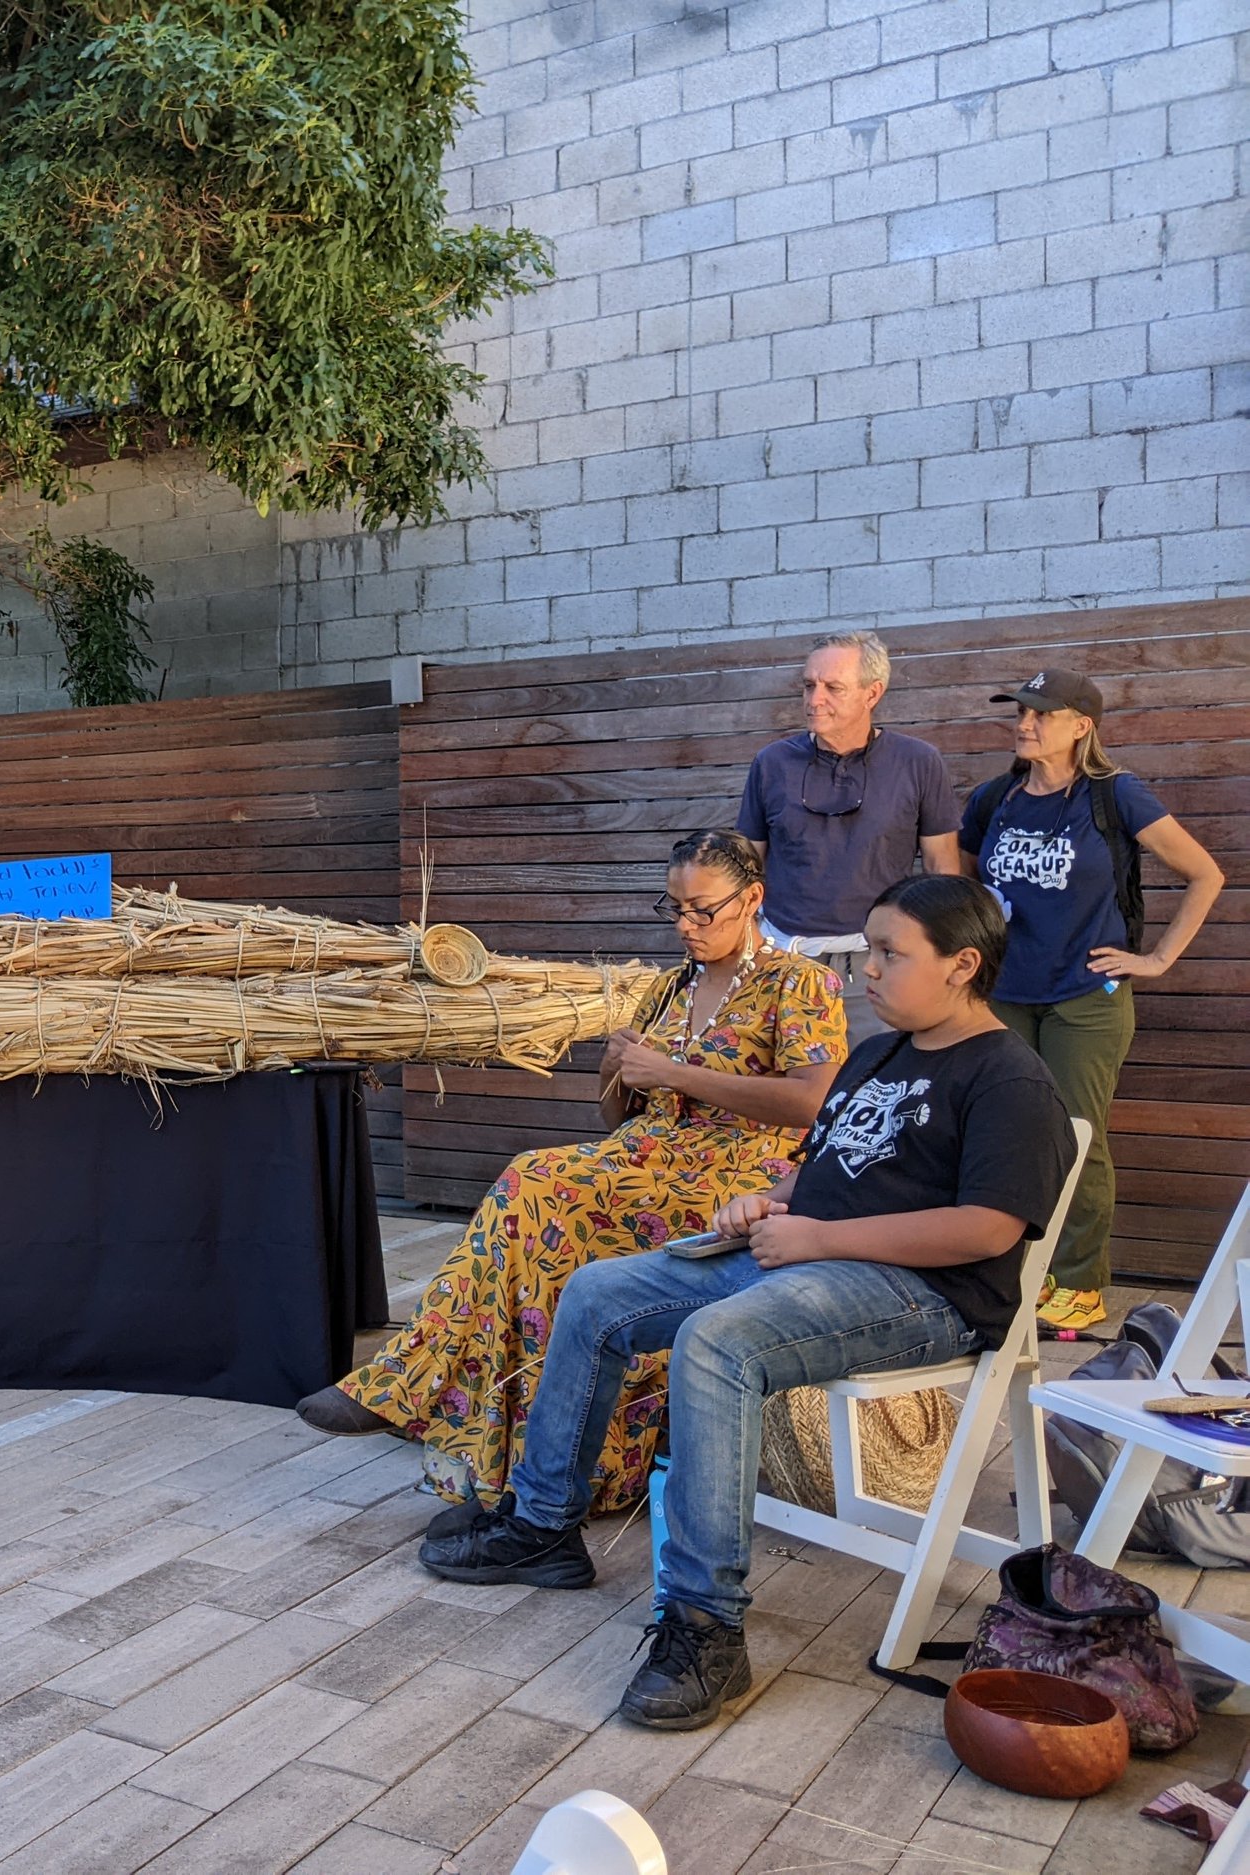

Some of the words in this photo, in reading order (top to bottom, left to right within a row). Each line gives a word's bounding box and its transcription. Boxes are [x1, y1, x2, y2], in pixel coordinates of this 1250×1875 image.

[1028, 672, 1046, 690] LA
[995, 840, 1070, 861] COASTAL
[988, 856, 1066, 879] CLEANUP
[1041, 874, 1062, 886] Day
[839, 1102, 885, 1135] 101
